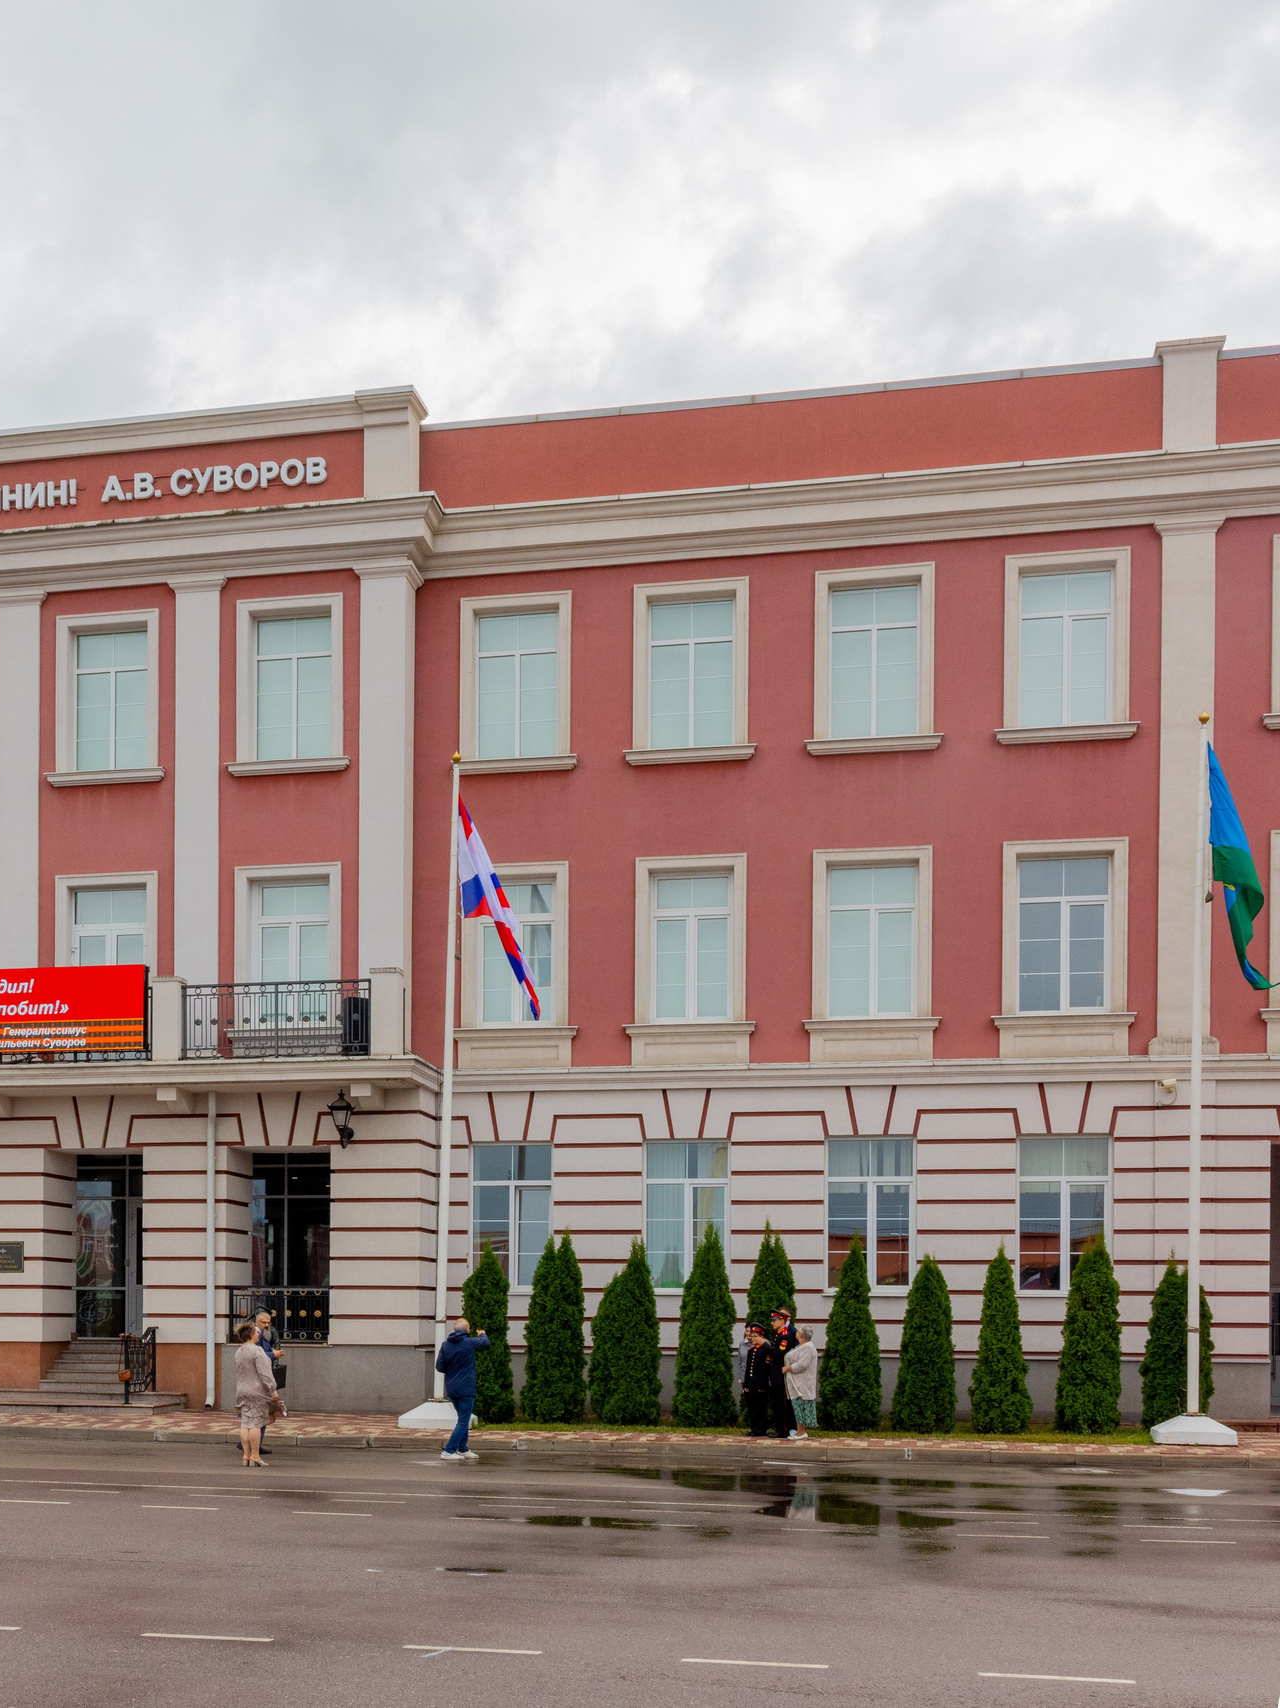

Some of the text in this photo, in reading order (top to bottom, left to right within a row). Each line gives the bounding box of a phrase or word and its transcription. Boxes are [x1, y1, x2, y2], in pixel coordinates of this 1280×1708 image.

[101, 471, 163, 503] А.В.
[169, 456, 328, 497] СУВОРОВ
[2, 1026, 88, 1038] Генералиссимус
[42, 1037, 87, 1050] Суворов
